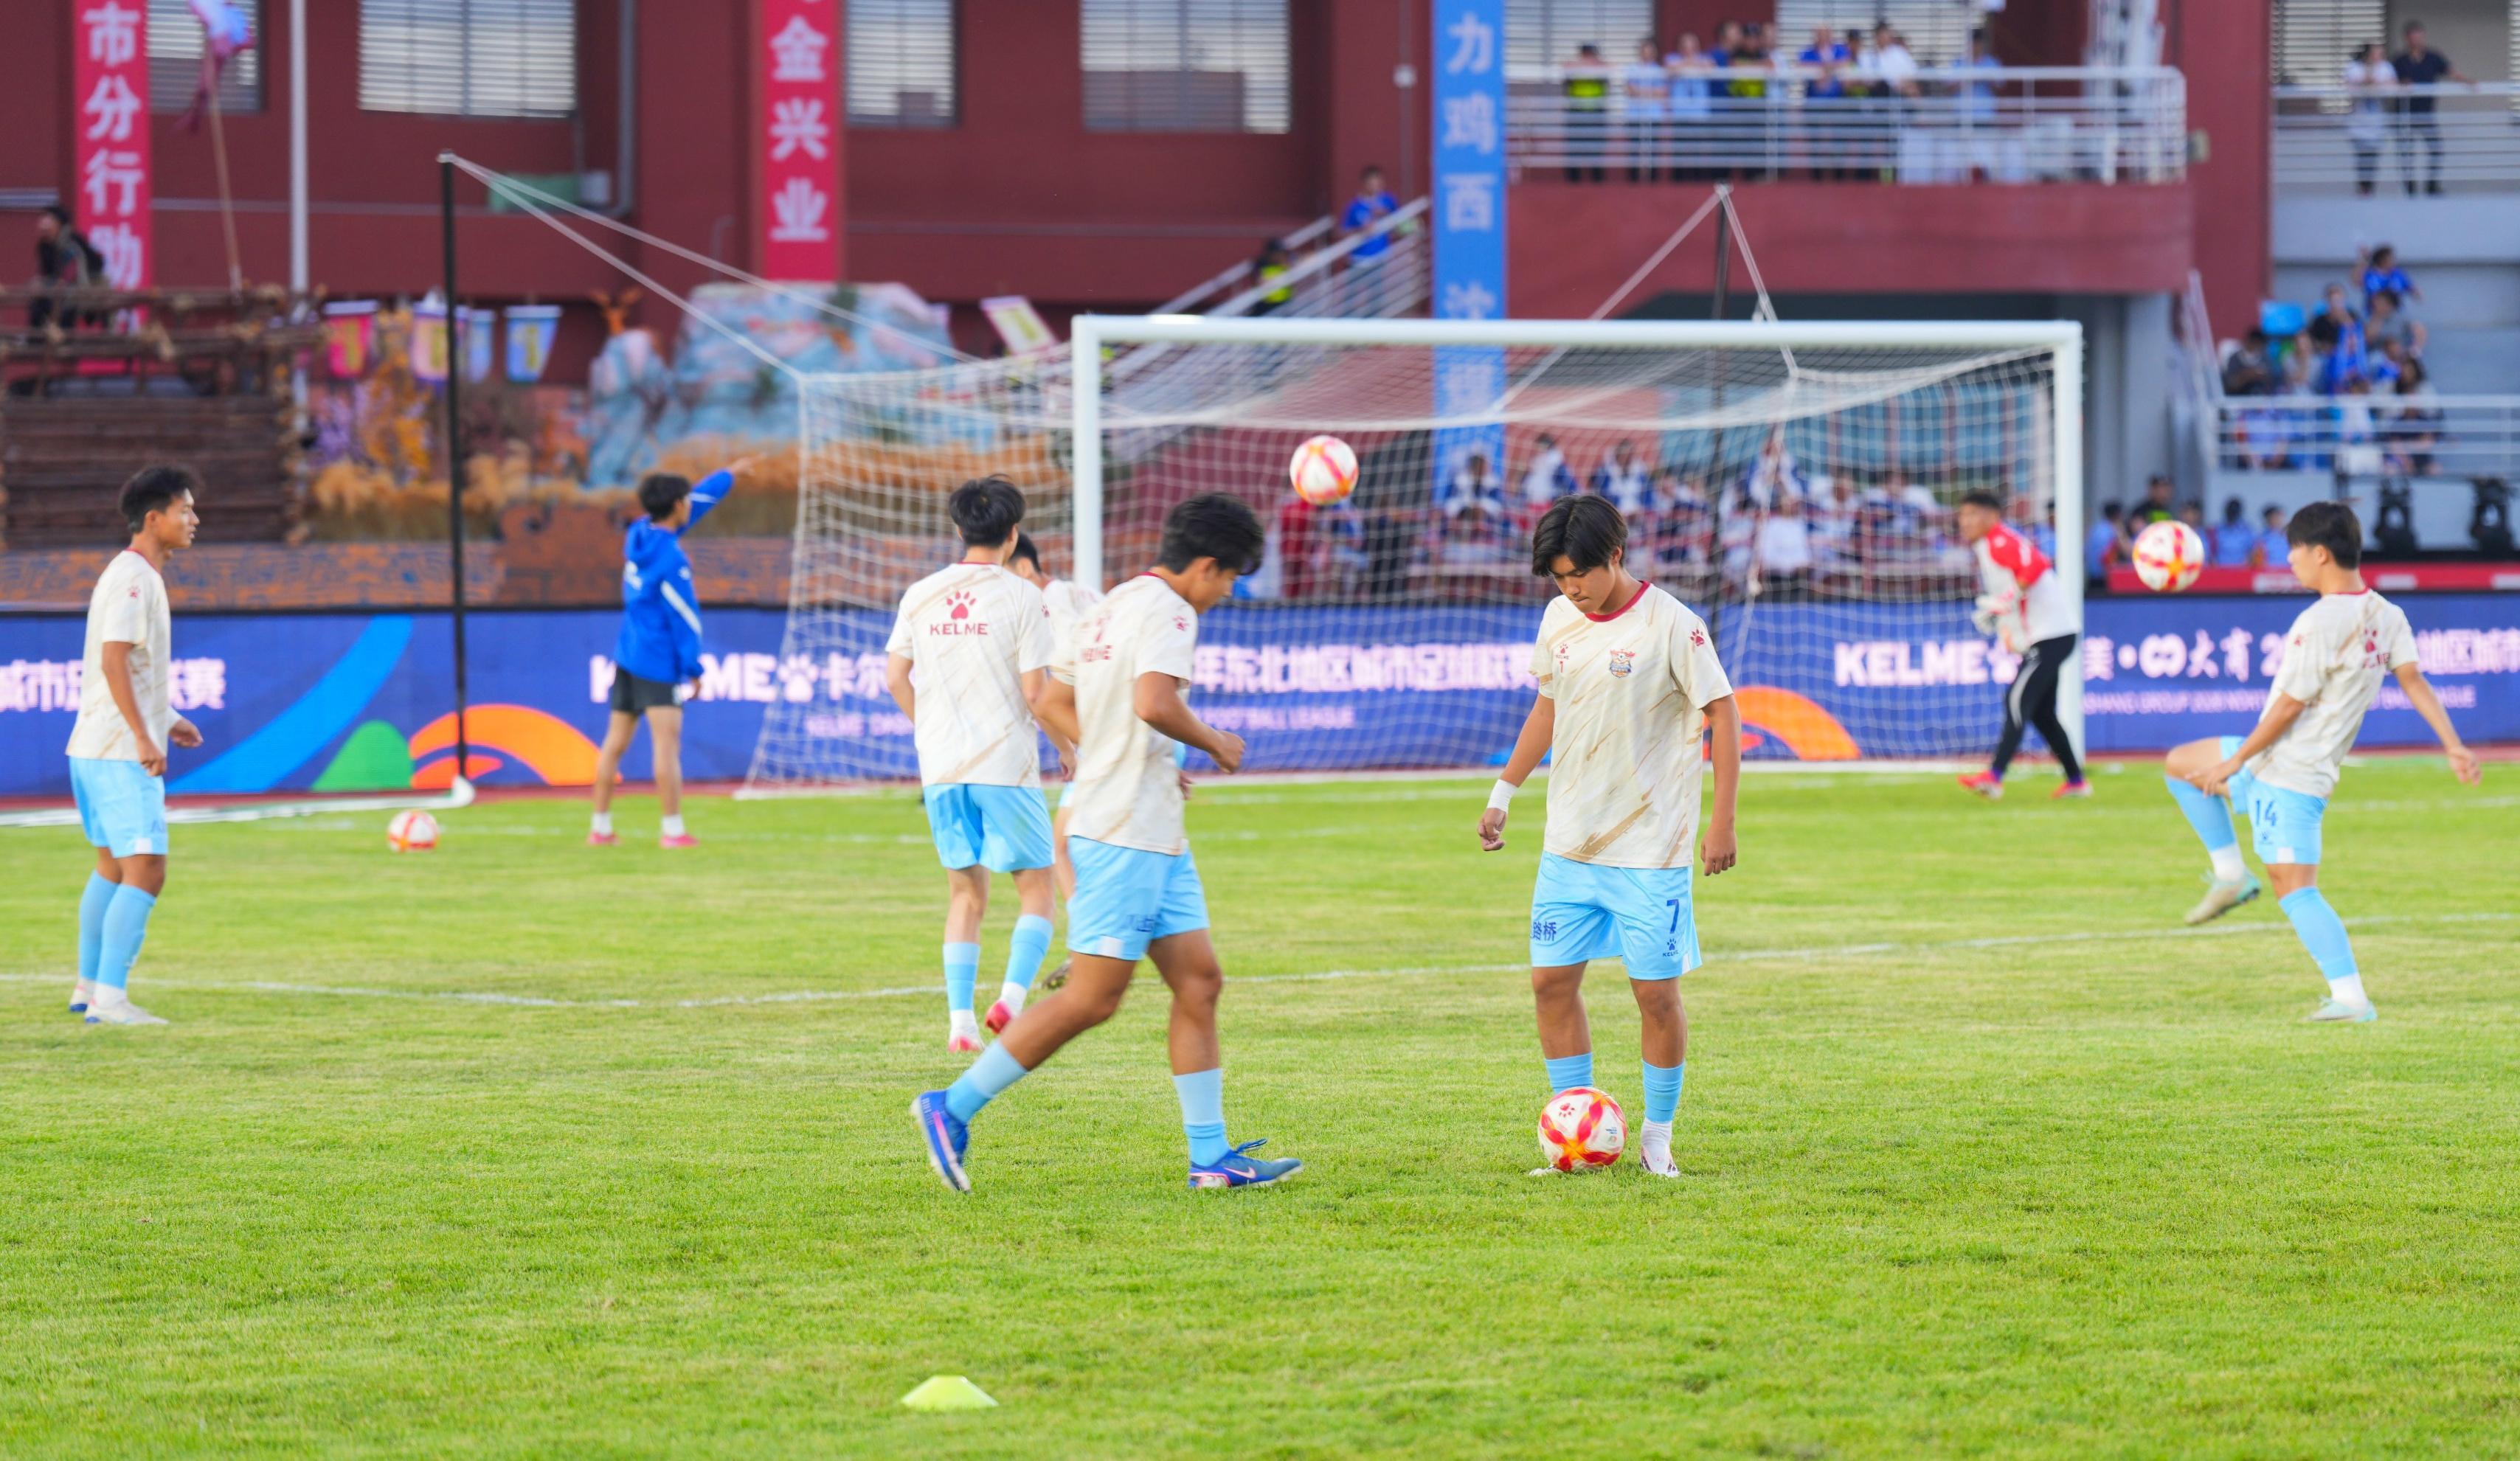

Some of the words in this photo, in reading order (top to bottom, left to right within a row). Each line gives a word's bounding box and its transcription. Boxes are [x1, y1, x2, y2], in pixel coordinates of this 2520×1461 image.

[769, 0, 828, 241] 金兴业
[930, 623, 989, 636] KELME
[1834, 640, 1989, 687] KELME
[2256, 799, 2277, 827] 14
[1666, 899, 1679, 934] 7
